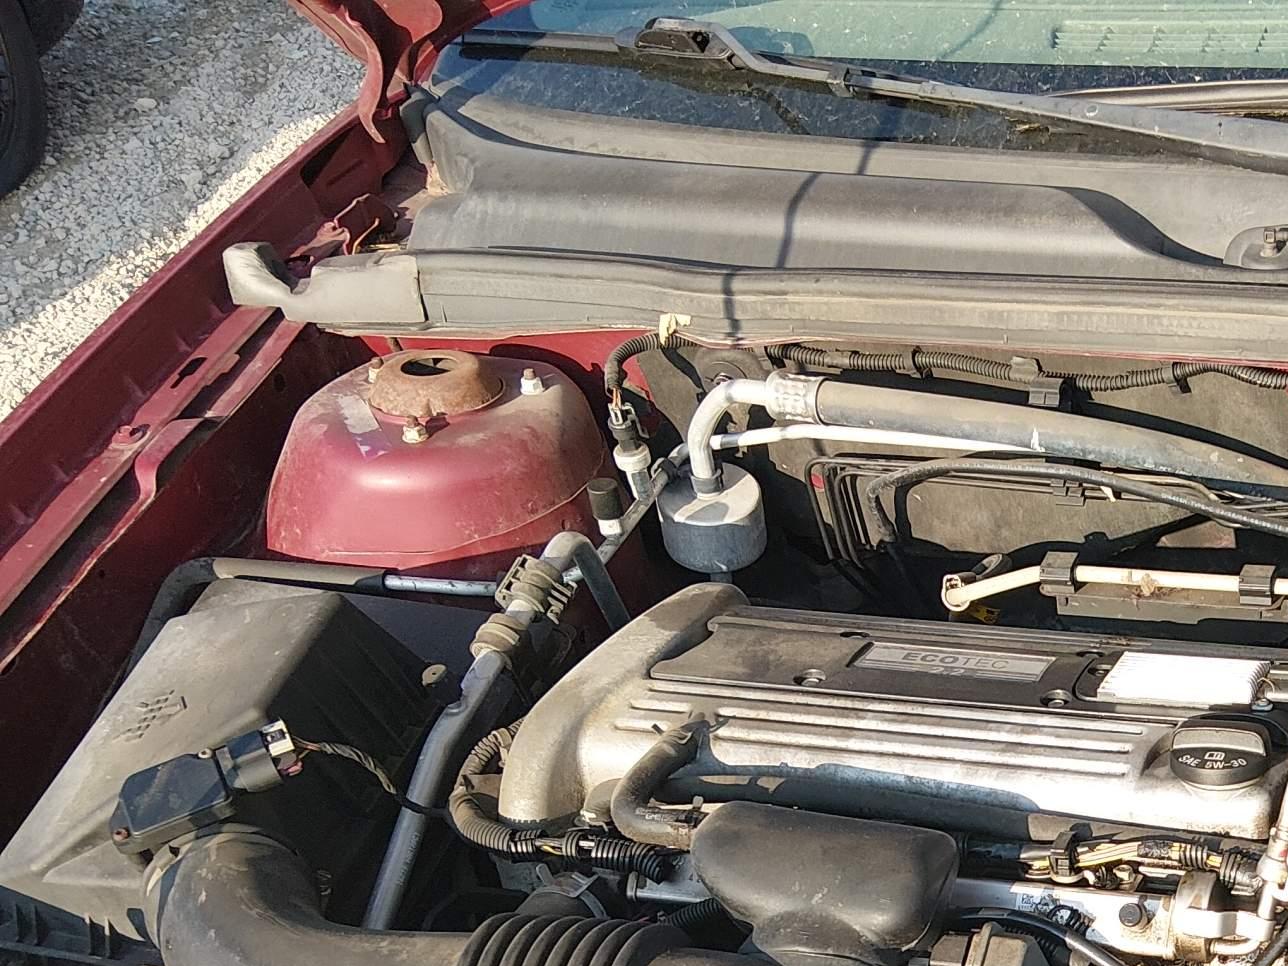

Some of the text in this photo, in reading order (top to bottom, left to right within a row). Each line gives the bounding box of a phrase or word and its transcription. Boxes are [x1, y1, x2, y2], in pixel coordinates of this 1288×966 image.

[902, 651, 1010, 670] ECOTEC
[929, 666, 967, 677] 2.2
[1178, 754, 1248, 769] SAE 5W-30
